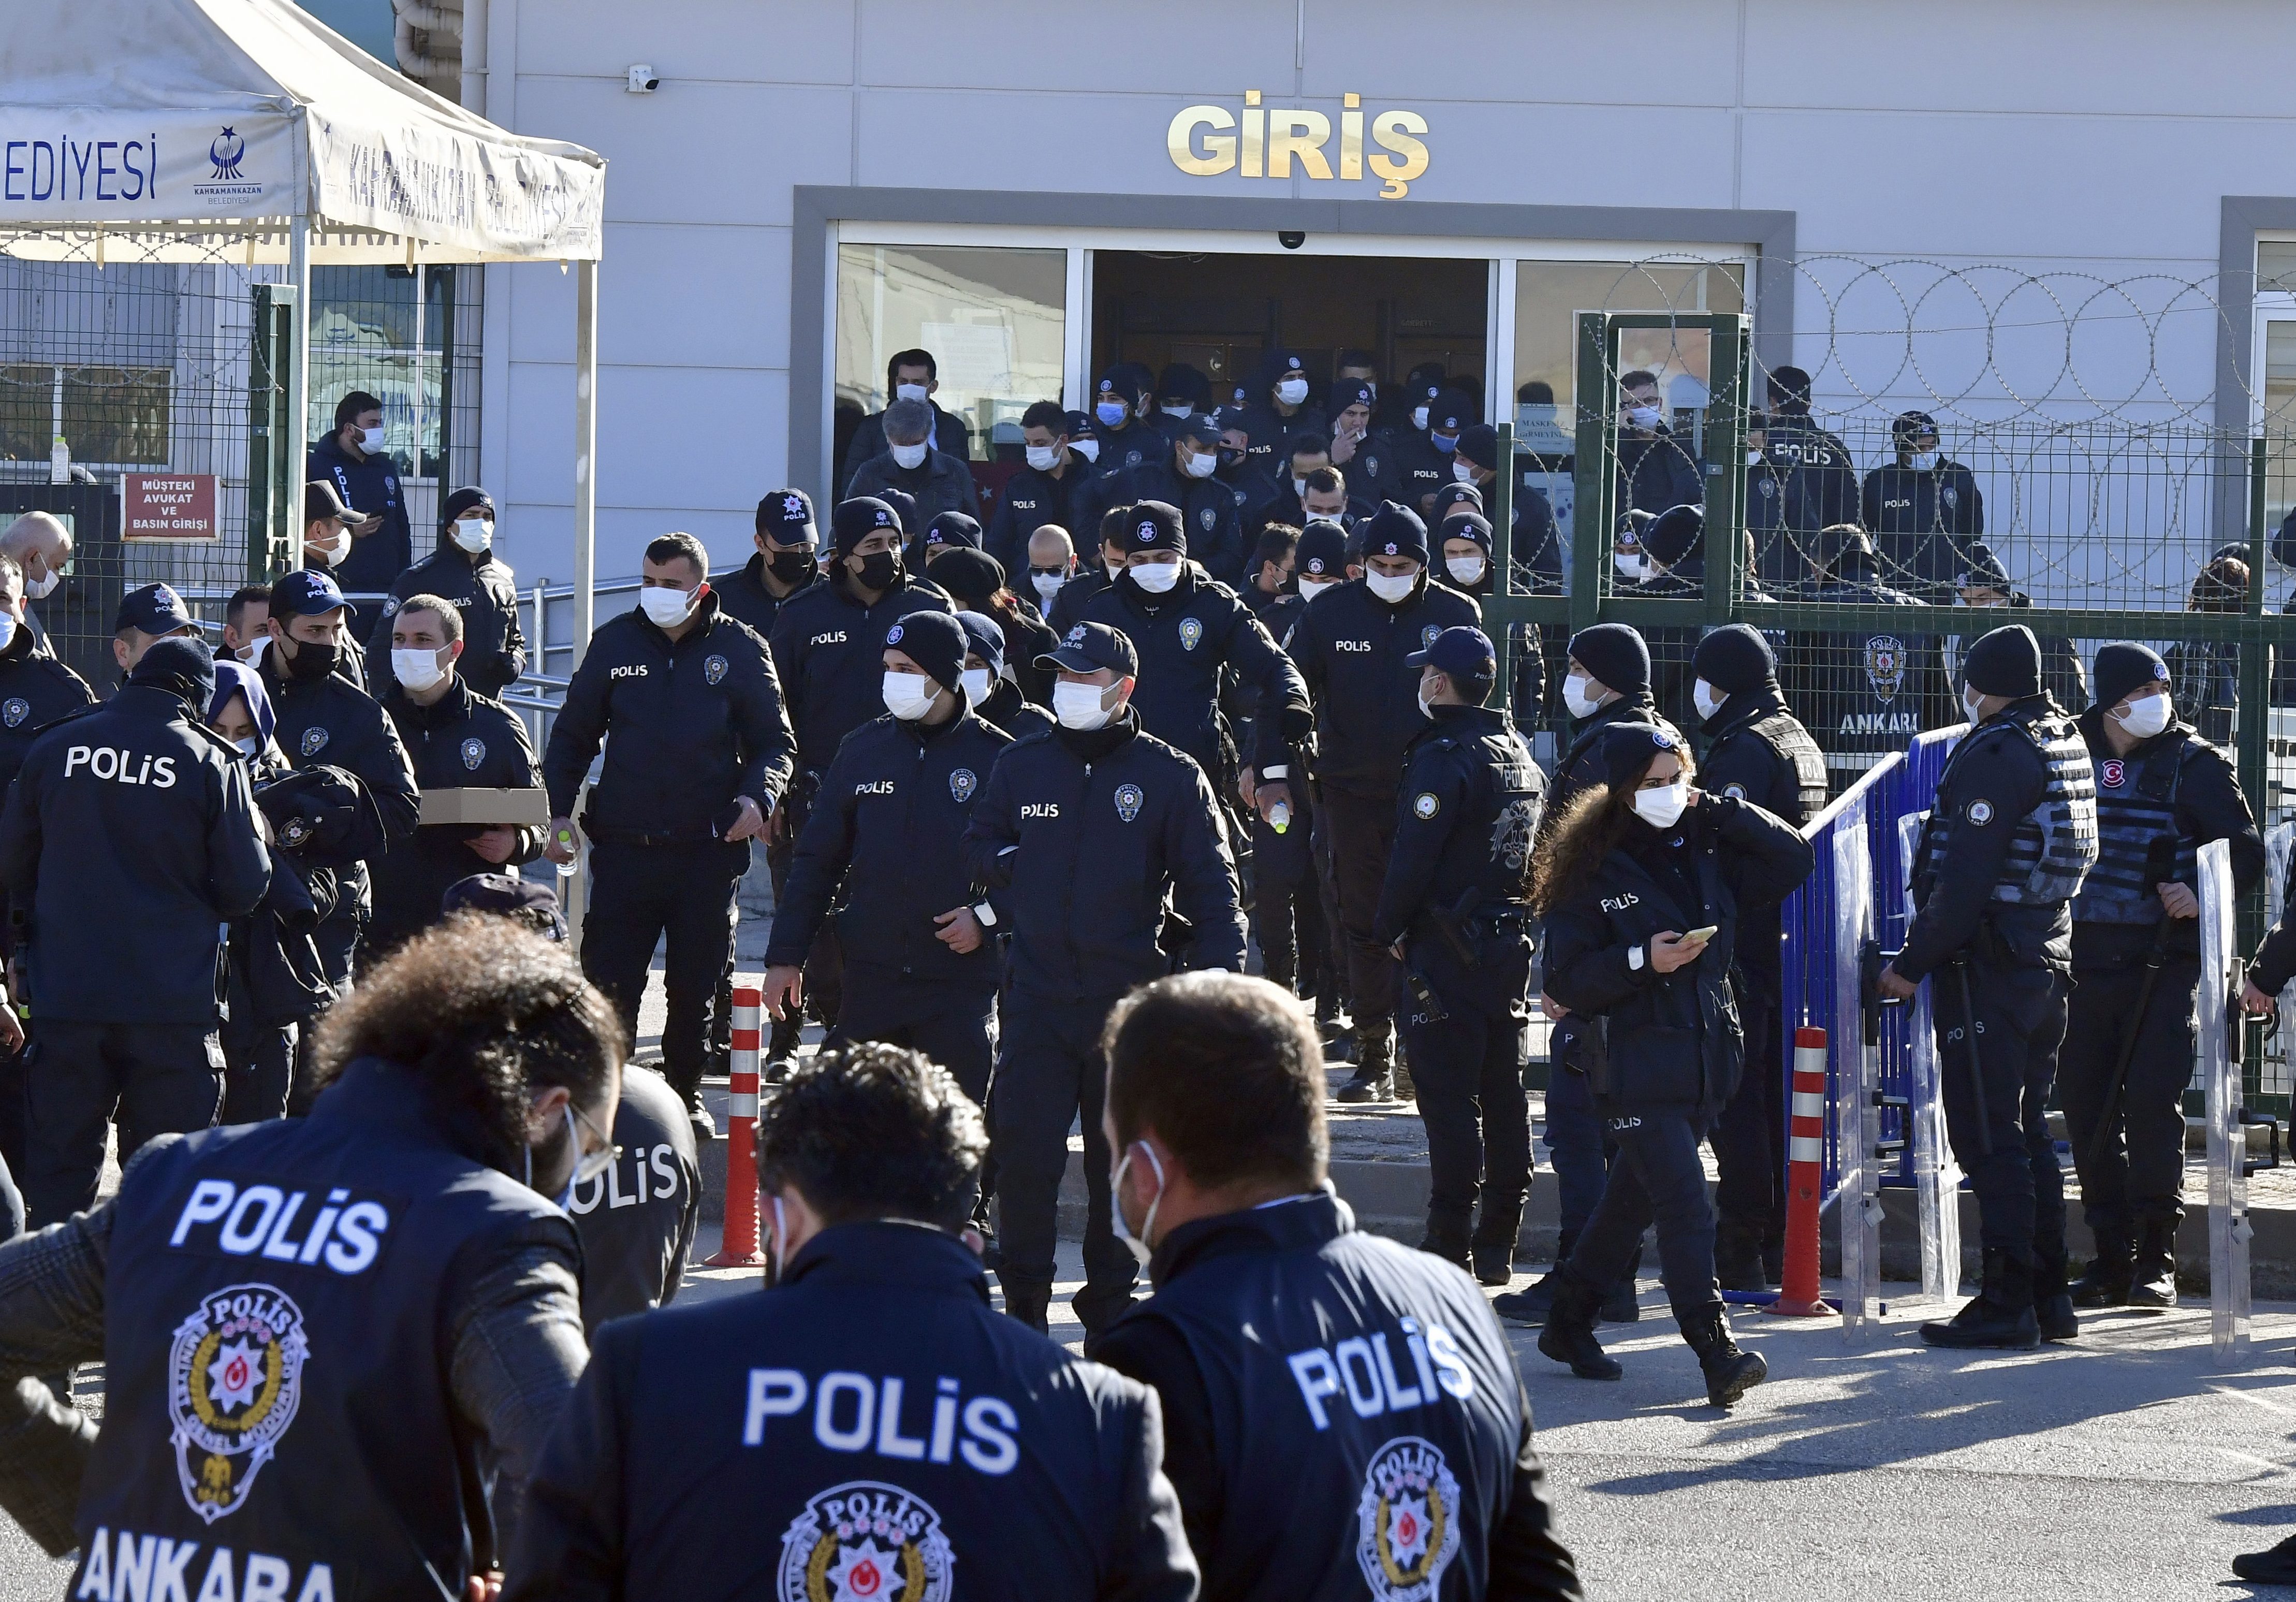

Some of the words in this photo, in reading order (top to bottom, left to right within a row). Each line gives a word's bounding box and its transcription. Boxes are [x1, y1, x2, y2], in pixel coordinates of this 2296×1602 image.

[1167, 90, 1429, 199] GİRİŞ
[5, 133, 155, 200] EDİYESİ
[208, 196, 249, 205] BELEDİYESİ
[142, 479, 195, 492] MÜŞTEKİ
[333, 466, 353, 510] POLİ
[143, 494, 193, 503] AVUKAT
[161, 506, 177, 516] VE
[133, 519, 169, 529] BASIN
[172, 518, 207, 531] GİRİŞİ
[1336, 640, 1371, 652] POLİS
[611, 664, 648, 679] POLİS
[64, 745, 176, 788] POLİS
[855, 781, 895, 796] POLİS
[1412, 1012, 1449, 1026] POS
[1947, 1021, 1985, 1043] POS
[569, 1143, 678, 1215] OLİS
[170, 1179, 389, 1275] POLİS
[213, 1293, 293, 1334] POLİS
[1288, 1317, 1473, 1431] POLİS
[742, 1367, 1019, 1475] POLİS
